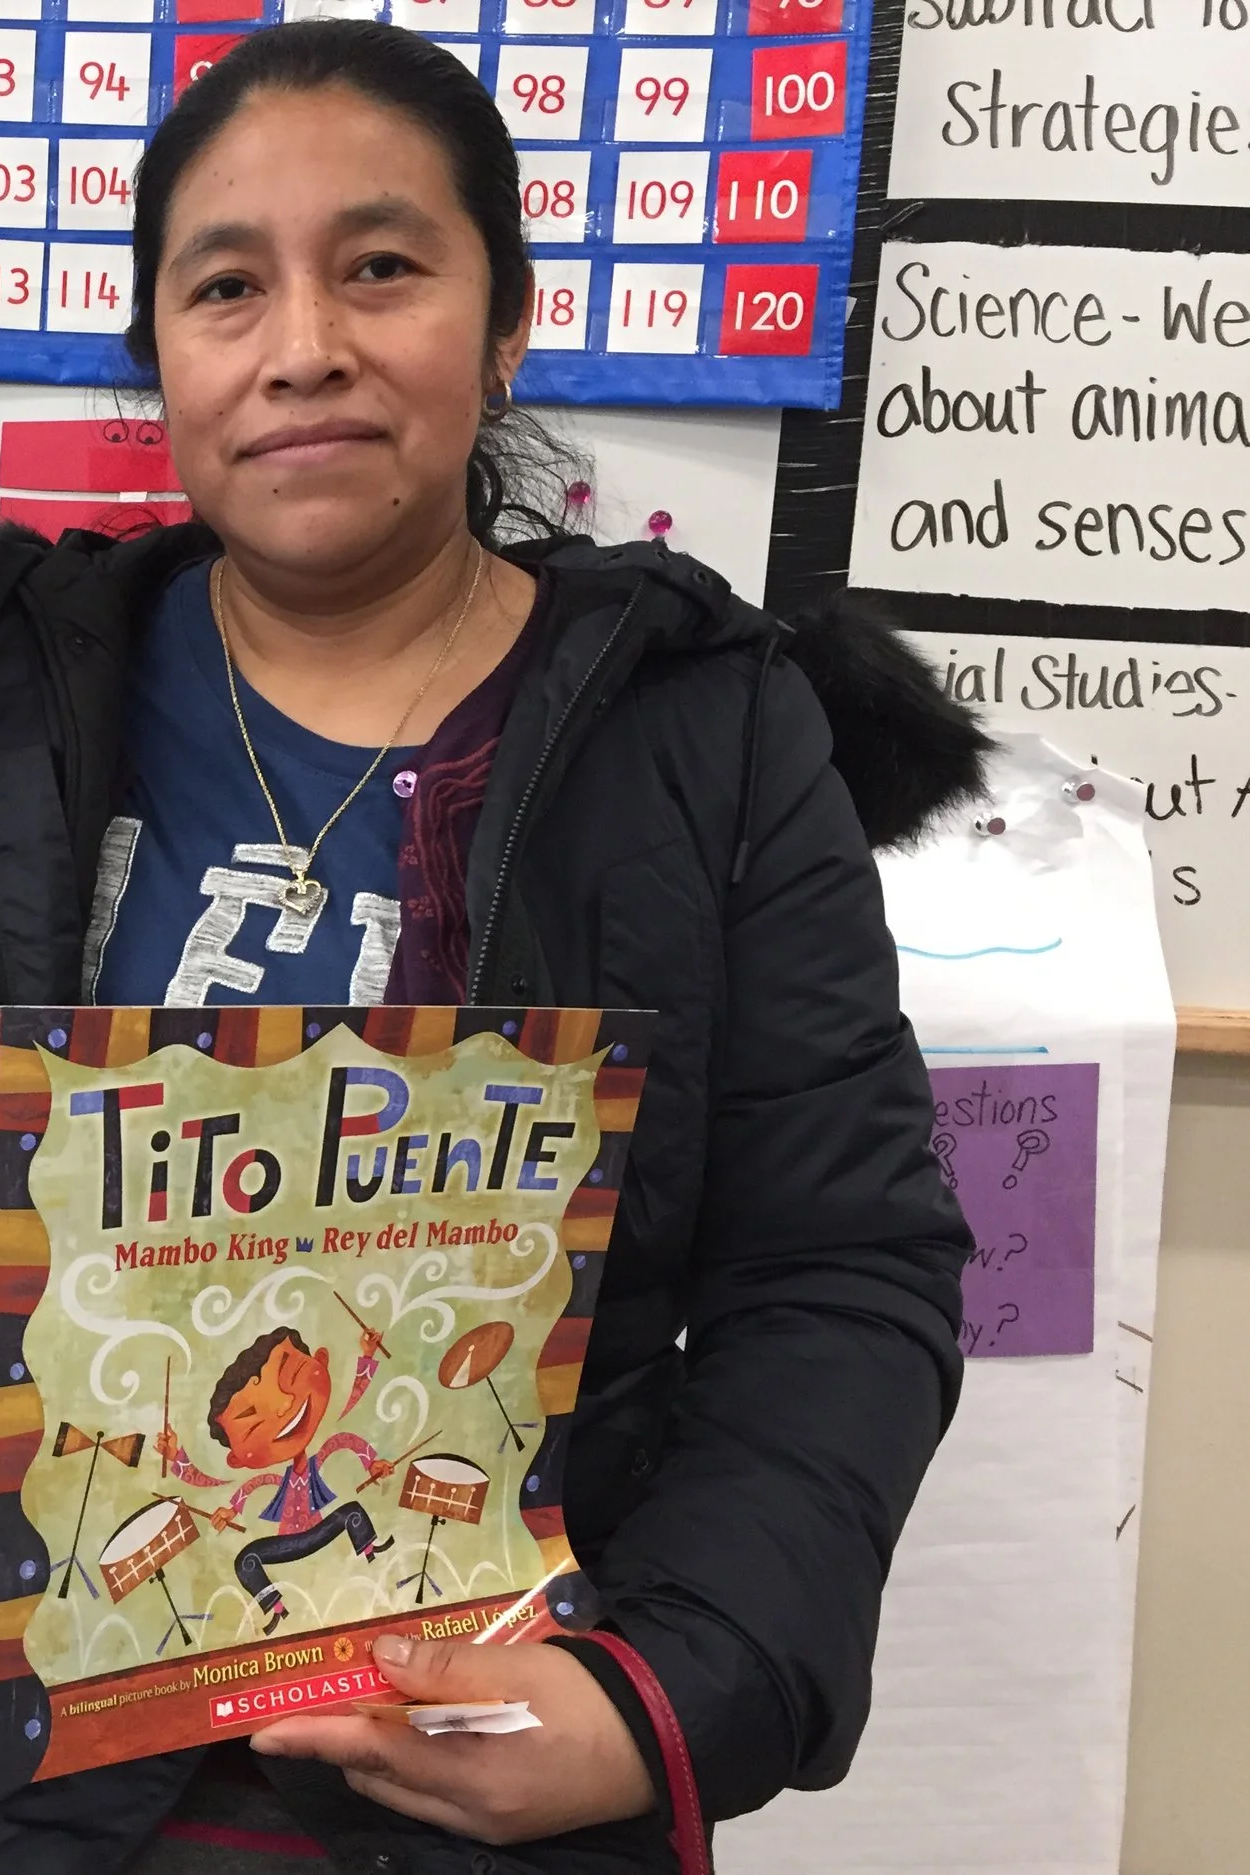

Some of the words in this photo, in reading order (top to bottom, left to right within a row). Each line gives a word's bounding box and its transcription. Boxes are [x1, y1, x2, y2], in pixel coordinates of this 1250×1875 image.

[79, 61, 129, 101] 94
[512, 73, 566, 115] 98
[634, 76, 690, 116] 99
[765, 71, 835, 116] 100
[942, 69, 1250, 185] Strategie
[70, 166, 130, 205] 104
[522, 179, 575, 219] 08
[627, 179, 694, 219] 109
[728, 179, 799, 220] 110
[60, 271, 119, 309] 114
[535, 288, 575, 326] 18
[622, 289, 687, 327] 119
[735, 291, 804, 331] 120
[1164, 280, 1250, 347] We
[877, 365, 1046, 437] about
[891, 479, 1008, 551] and
[1036, 500, 1247, 565] senses
[944, 647, 1005, 702] ial
[934, 1080, 1058, 1126] estions
[115, 1236, 217, 1272] Mambo
[226, 1233, 290, 1264] King
[321, 1227, 372, 1257] Rey
[376, 1221, 419, 1249] del
[425, 1218, 519, 1247] Mambo
[421, 1611, 480, 1641] Rafael
[60, 1706, 68, 1717] A
[69, 1694, 117, 1716] bilingual
[119, 1688, 154, 1706] picture
[154, 1682, 178, 1697] book
[179, 1679, 191, 1692] by
[193, 1659, 260, 1688] Monica
[264, 1645, 324, 1673] Brown
